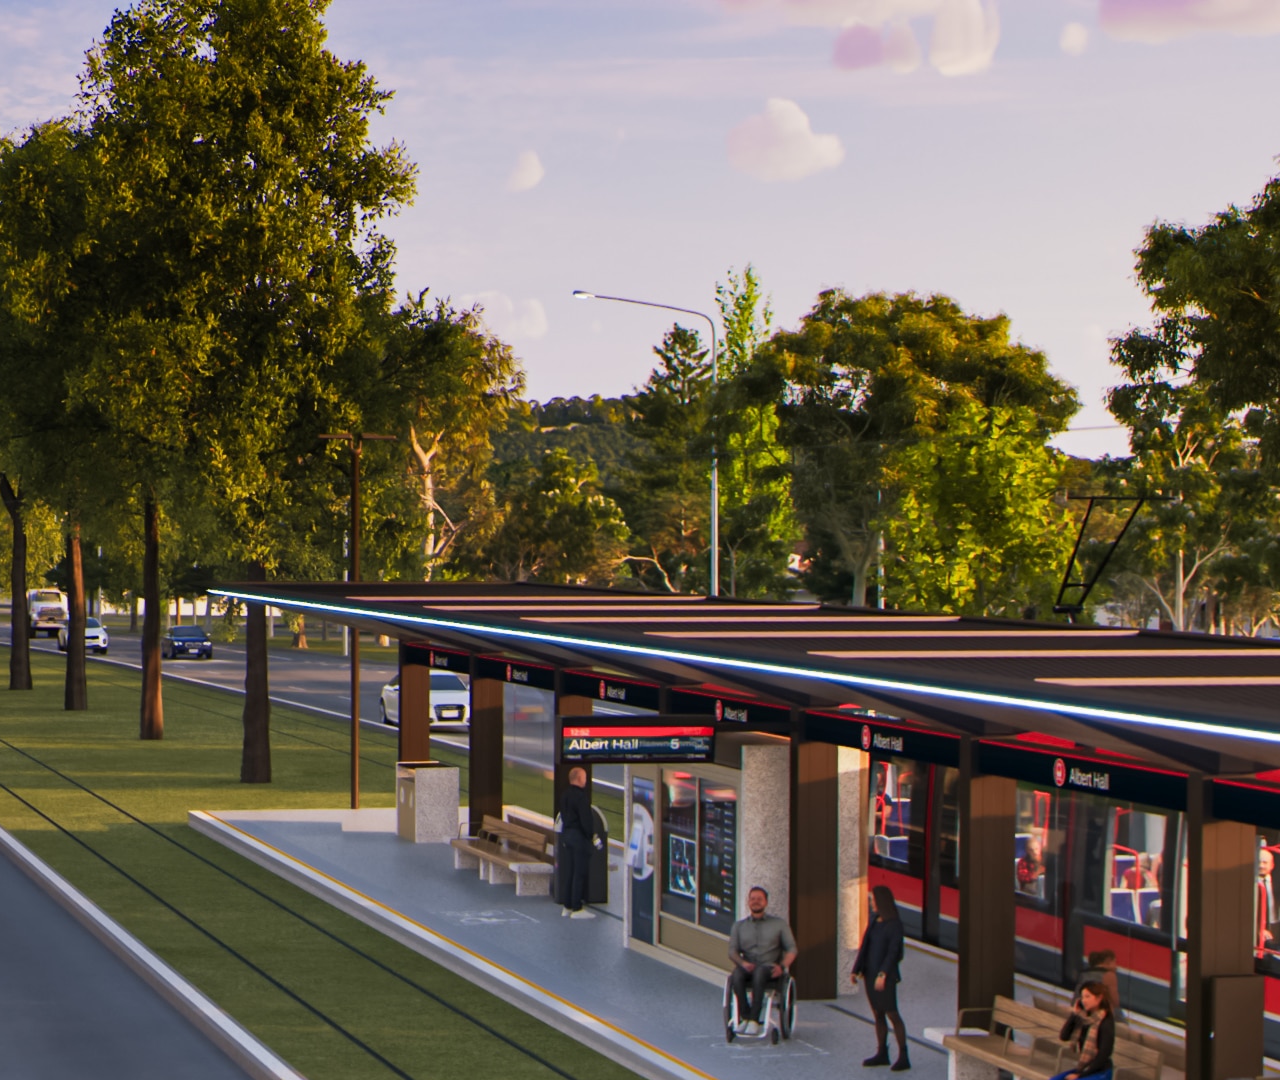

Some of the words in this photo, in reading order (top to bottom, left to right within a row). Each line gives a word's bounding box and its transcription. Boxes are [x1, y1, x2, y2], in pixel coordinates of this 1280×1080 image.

[724, 707, 737, 720] Albert
[737, 709, 748, 722] Hall
[568, 739, 609, 750] Albert
[612, 739, 639, 750] Hall
[873, 733, 890, 749] Albert
[890, 737, 903, 751] Hall
[1069, 768, 1093, 787] Albert
[1093, 773, 1110, 790] Hall
